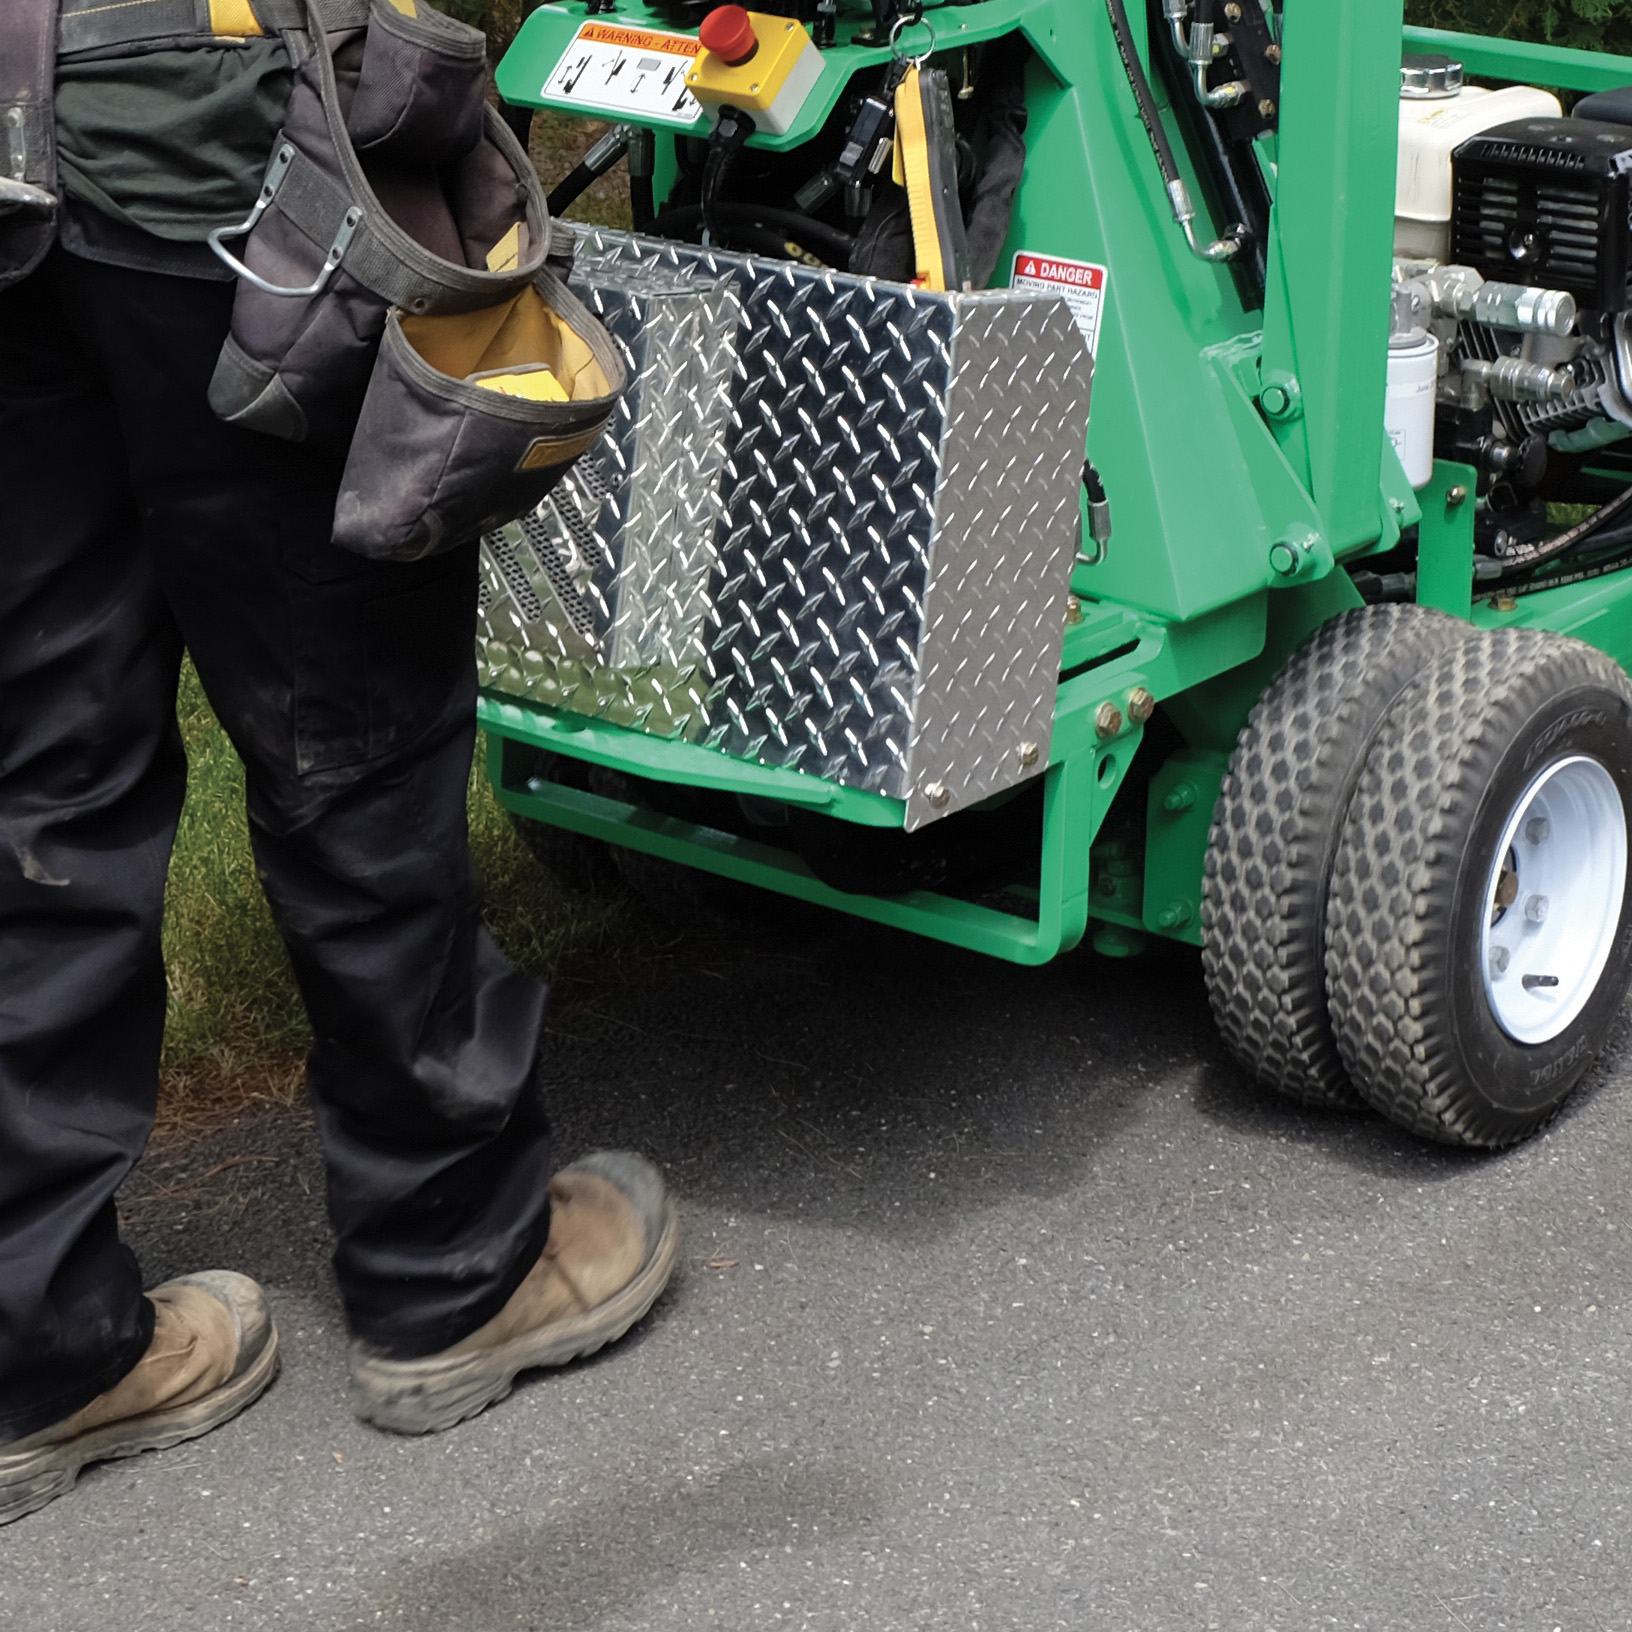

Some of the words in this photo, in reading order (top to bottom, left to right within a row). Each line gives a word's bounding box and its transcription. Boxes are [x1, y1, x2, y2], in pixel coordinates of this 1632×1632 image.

[597, 29, 654, 47] WARNING
[661, 39, 701, 54] ATTEN
[1040, 262, 1093, 285] DANGER
